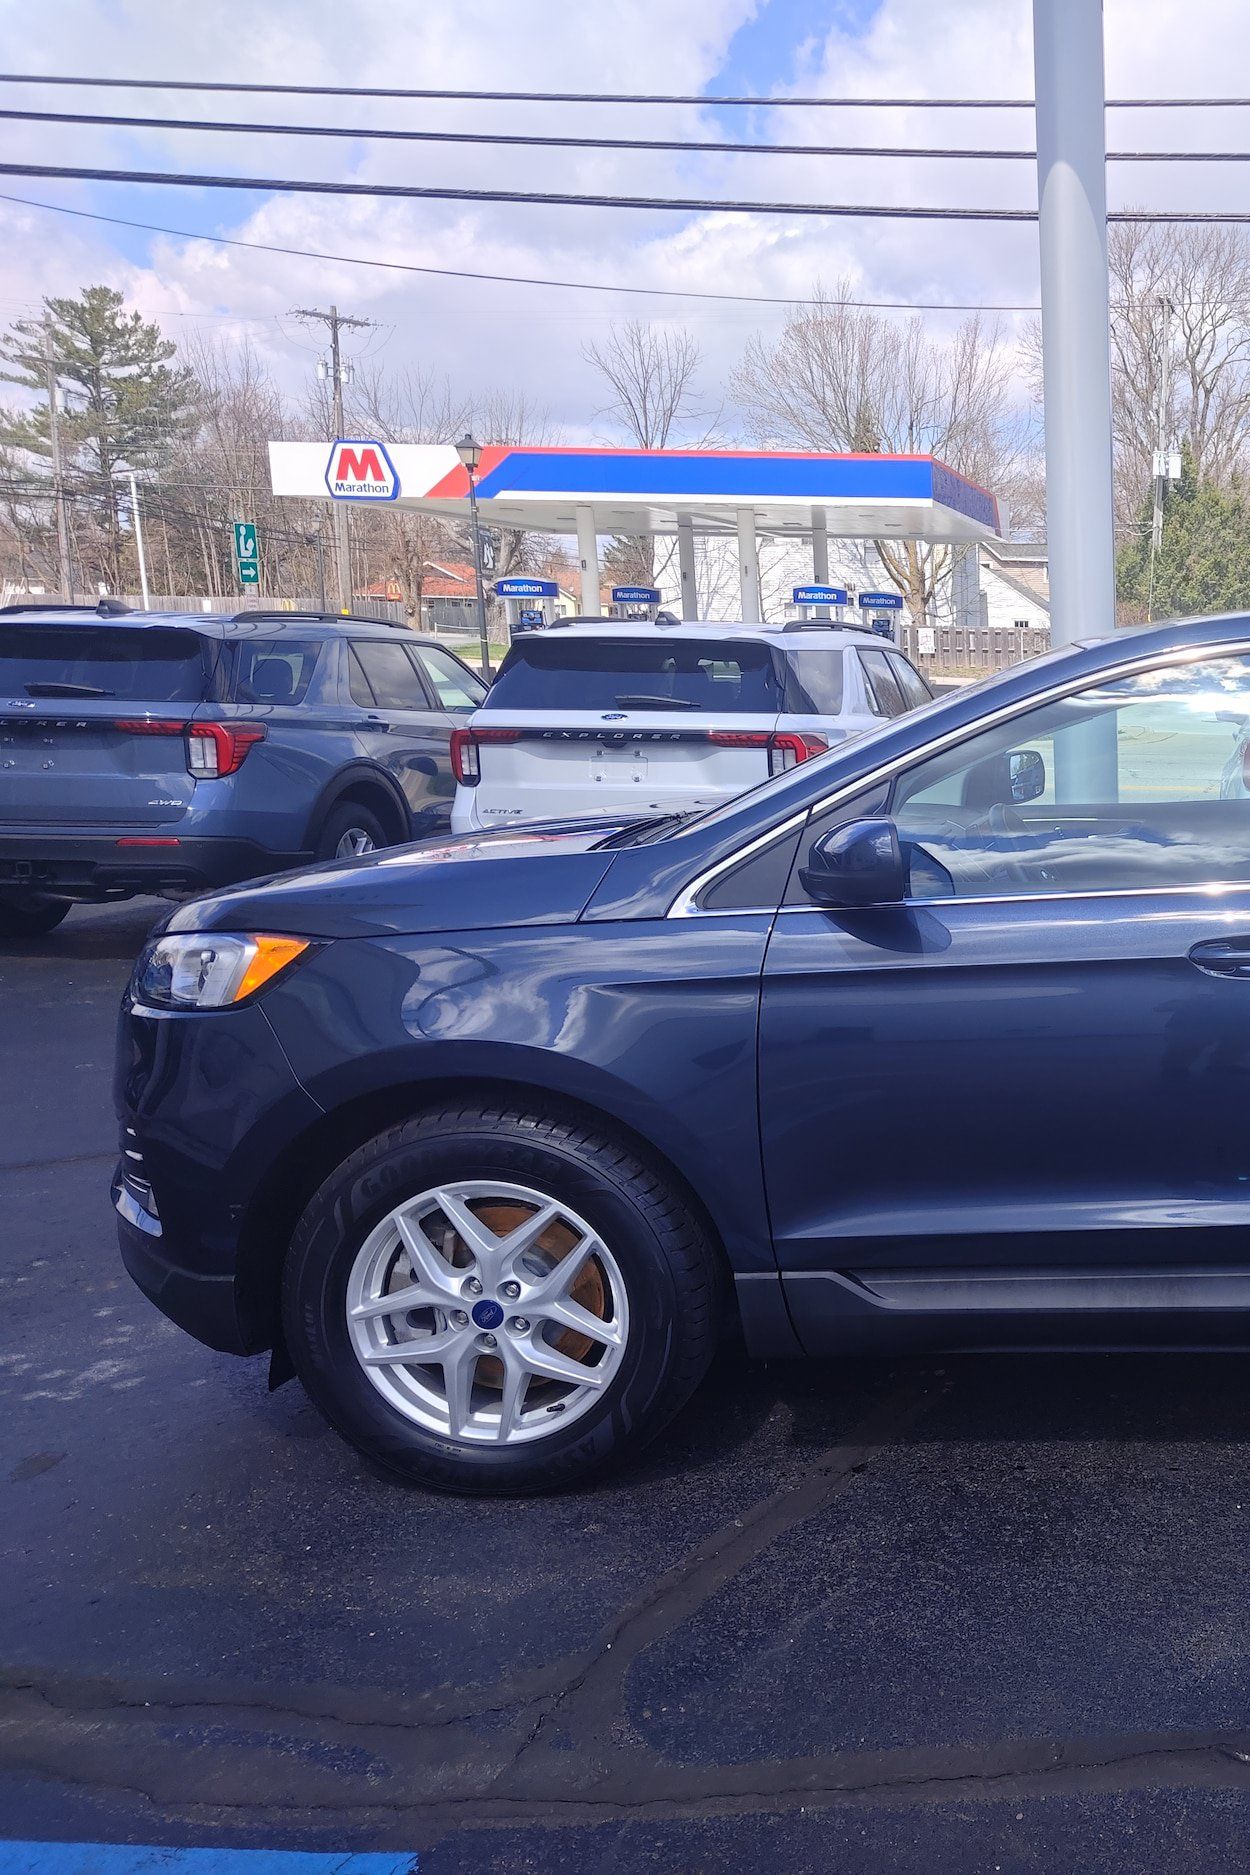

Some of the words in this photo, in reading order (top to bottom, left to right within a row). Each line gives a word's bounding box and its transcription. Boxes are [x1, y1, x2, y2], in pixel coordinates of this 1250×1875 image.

[336, 448, 386, 482] M
[335, 483, 389, 493] Marathon
[503, 584, 543, 593] Marathon
[616, 591, 650, 599] Marathon
[798, 591, 837, 600] Marathon
[862, 597, 896, 605] Marathon
[542, 732, 681, 740] EXPLORER
